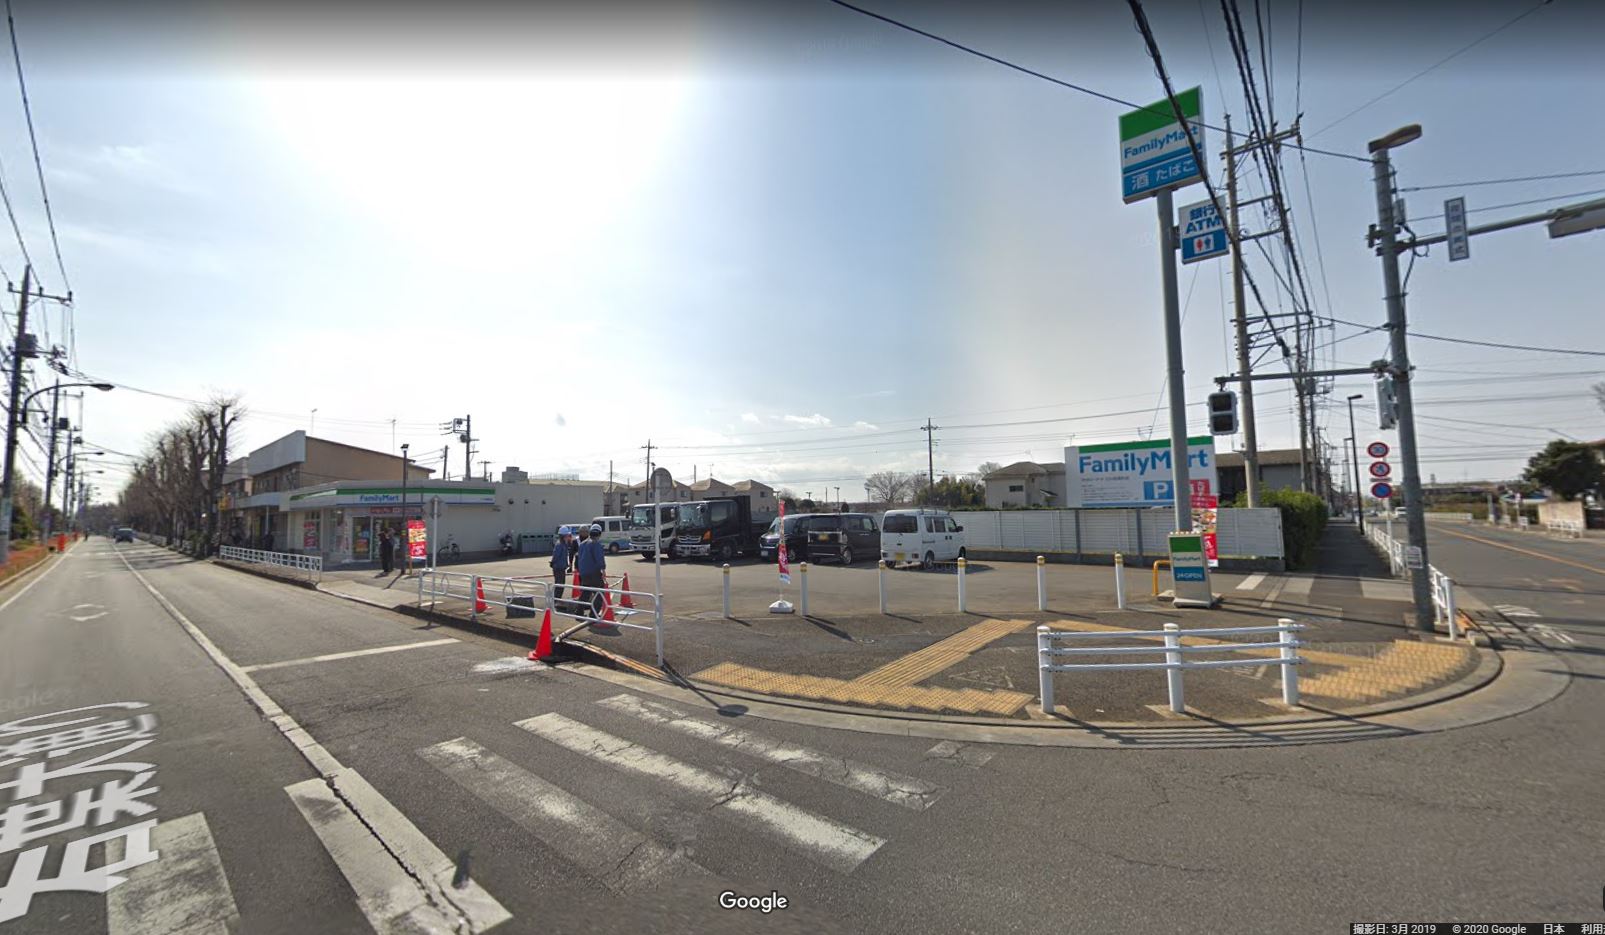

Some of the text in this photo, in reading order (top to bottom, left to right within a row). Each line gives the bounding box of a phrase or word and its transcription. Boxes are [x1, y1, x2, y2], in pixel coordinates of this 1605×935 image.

[1123, 125, 1199, 159] FamilyMat
[1131, 159, 1195, 190] 酒 たばこ
[1185, 214, 1221, 235] ATM
[1079, 449, 1209, 476] FamilyMrt
[1153, 482, 1169, 499] P
